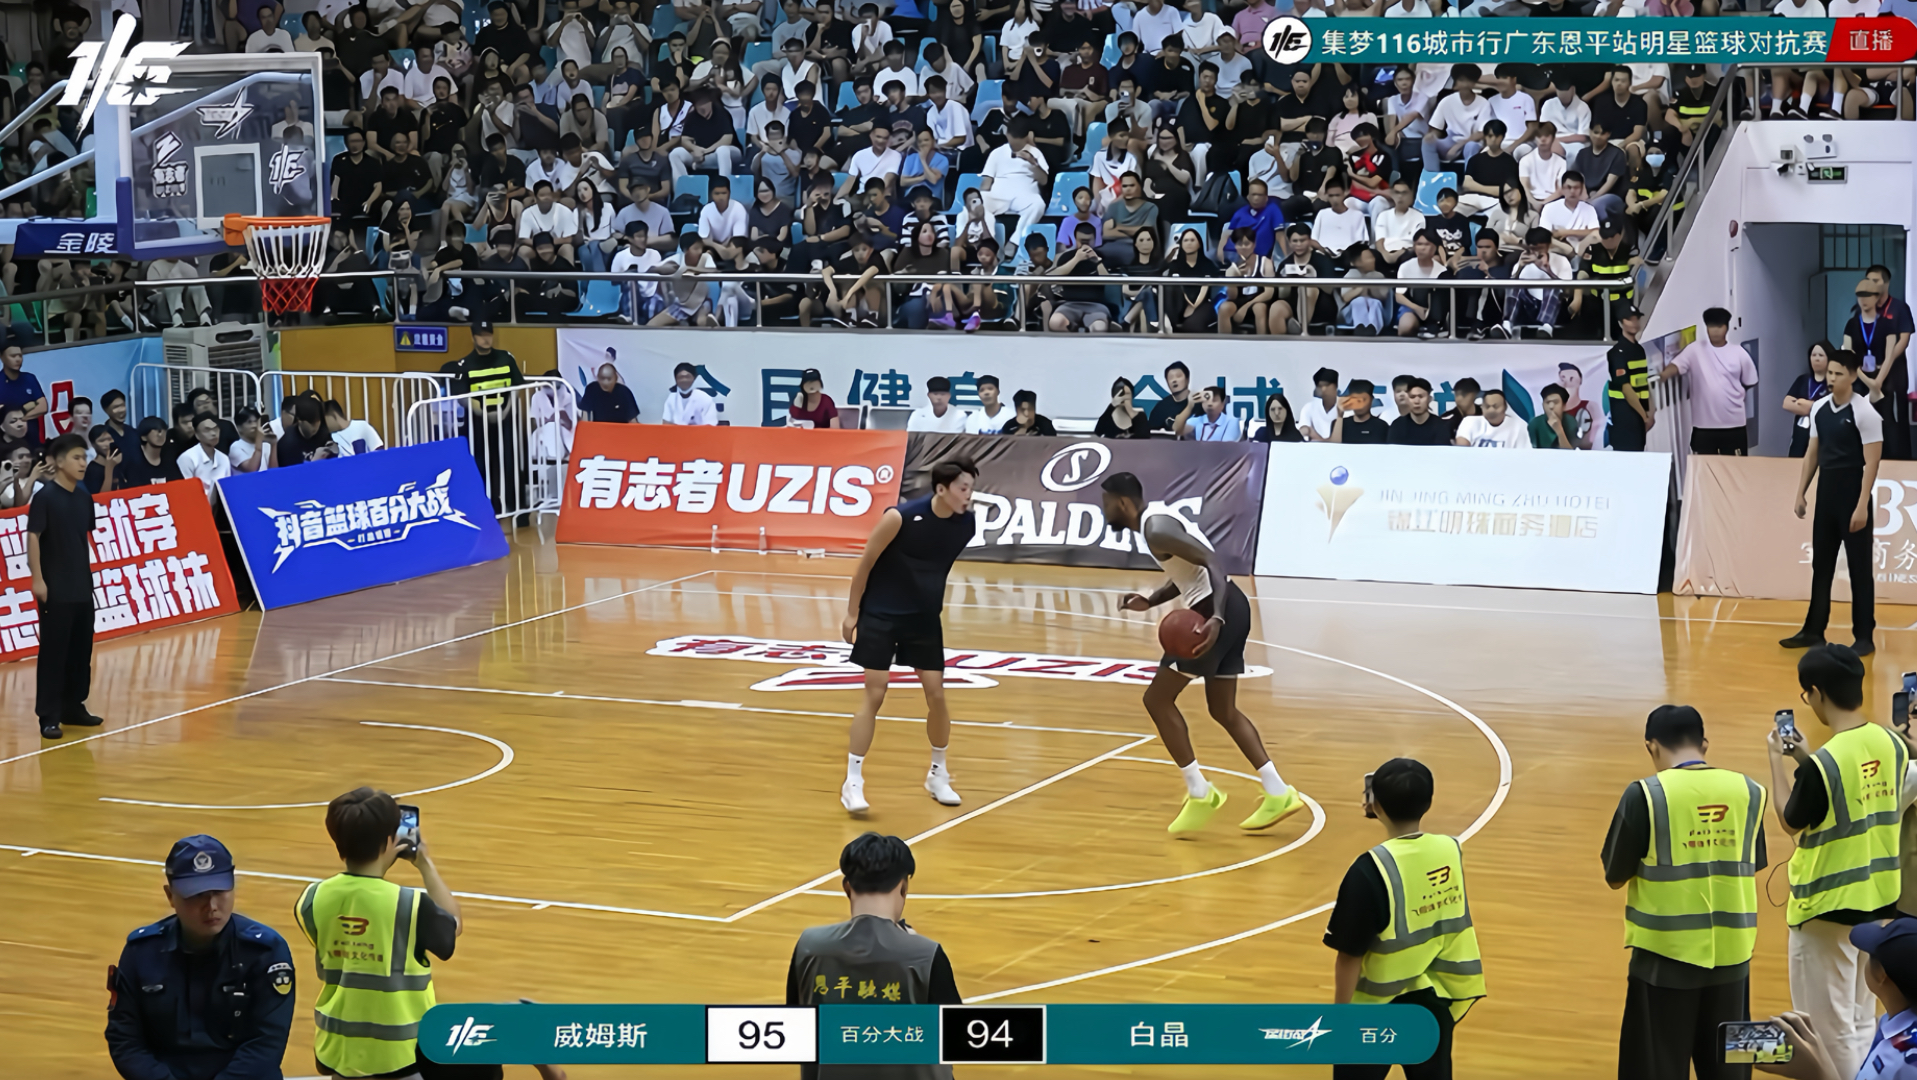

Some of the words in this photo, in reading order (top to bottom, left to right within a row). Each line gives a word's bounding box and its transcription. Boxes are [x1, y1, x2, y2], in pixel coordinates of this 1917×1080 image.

[43, 232, 119, 254] 金陵
[274, 486, 453, 549] 抖音篮球百分大战
